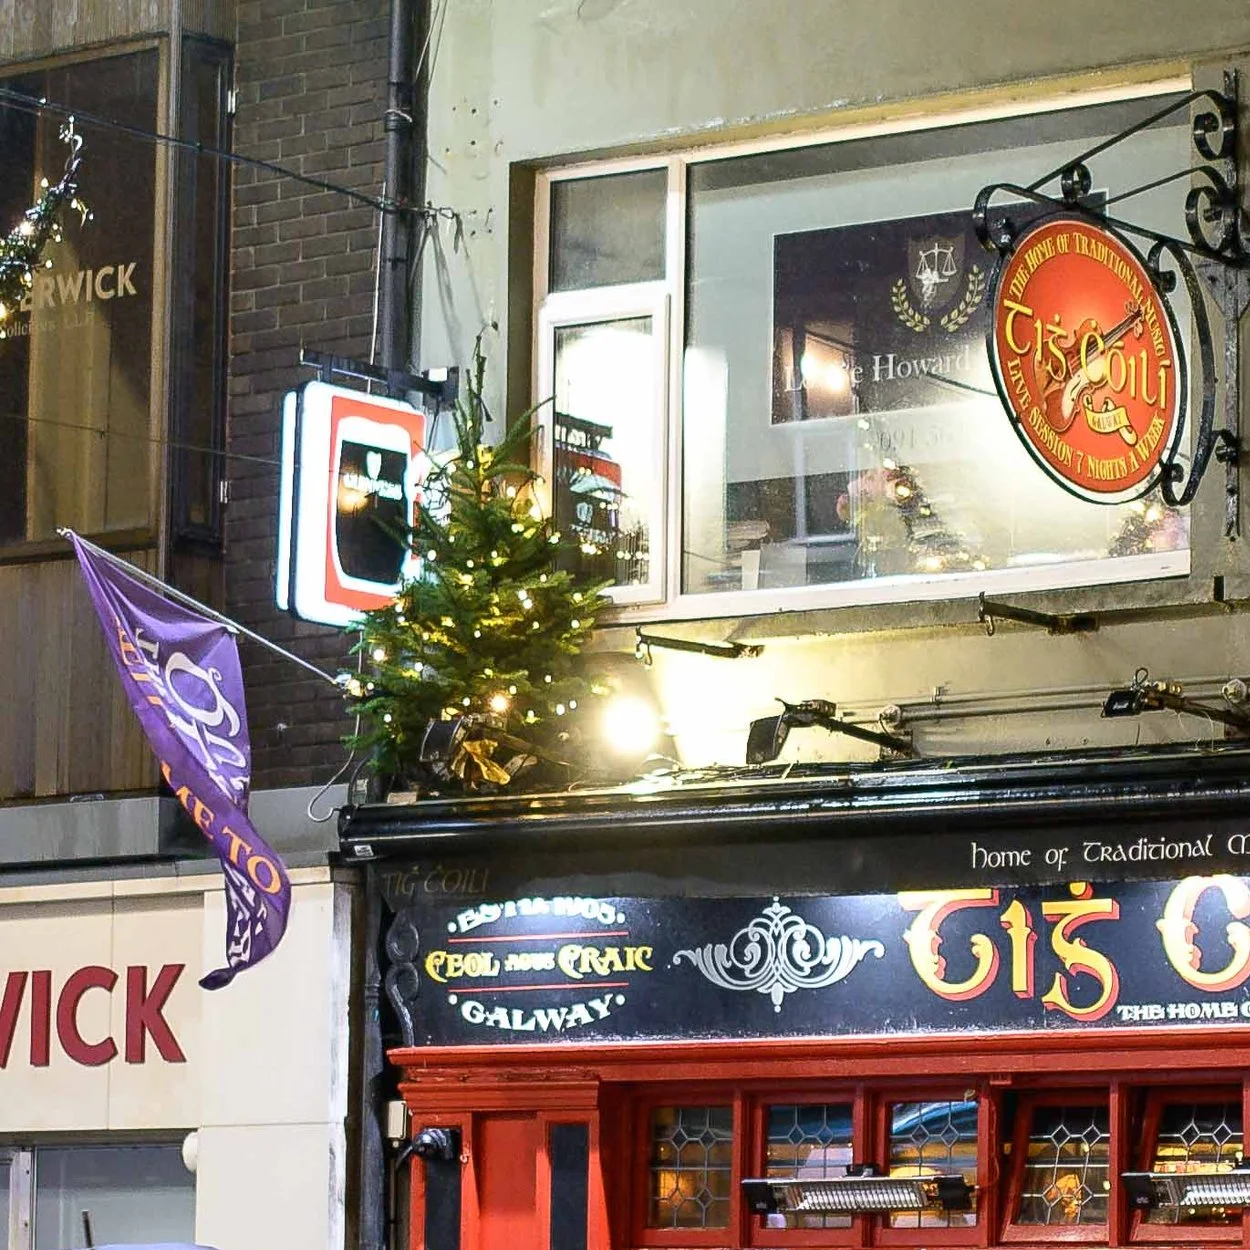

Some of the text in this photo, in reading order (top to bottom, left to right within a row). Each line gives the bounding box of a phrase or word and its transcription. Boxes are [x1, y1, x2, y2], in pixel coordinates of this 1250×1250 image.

[1024, 237, 1056, 269] HOME
[1056, 233, 1071, 253] OF
[1007, 356, 1032, 411] LIVE
[1076, 451, 1084, 474] 7
[1128, 450, 1140, 474] A
[222, 825, 283, 895] TO
[1045, 846, 1069, 872] of
[461, 993, 614, 1033] GALWAY
[1117, 1004, 1165, 1021] THE
[1166, 1002, 1238, 1020] HOME
